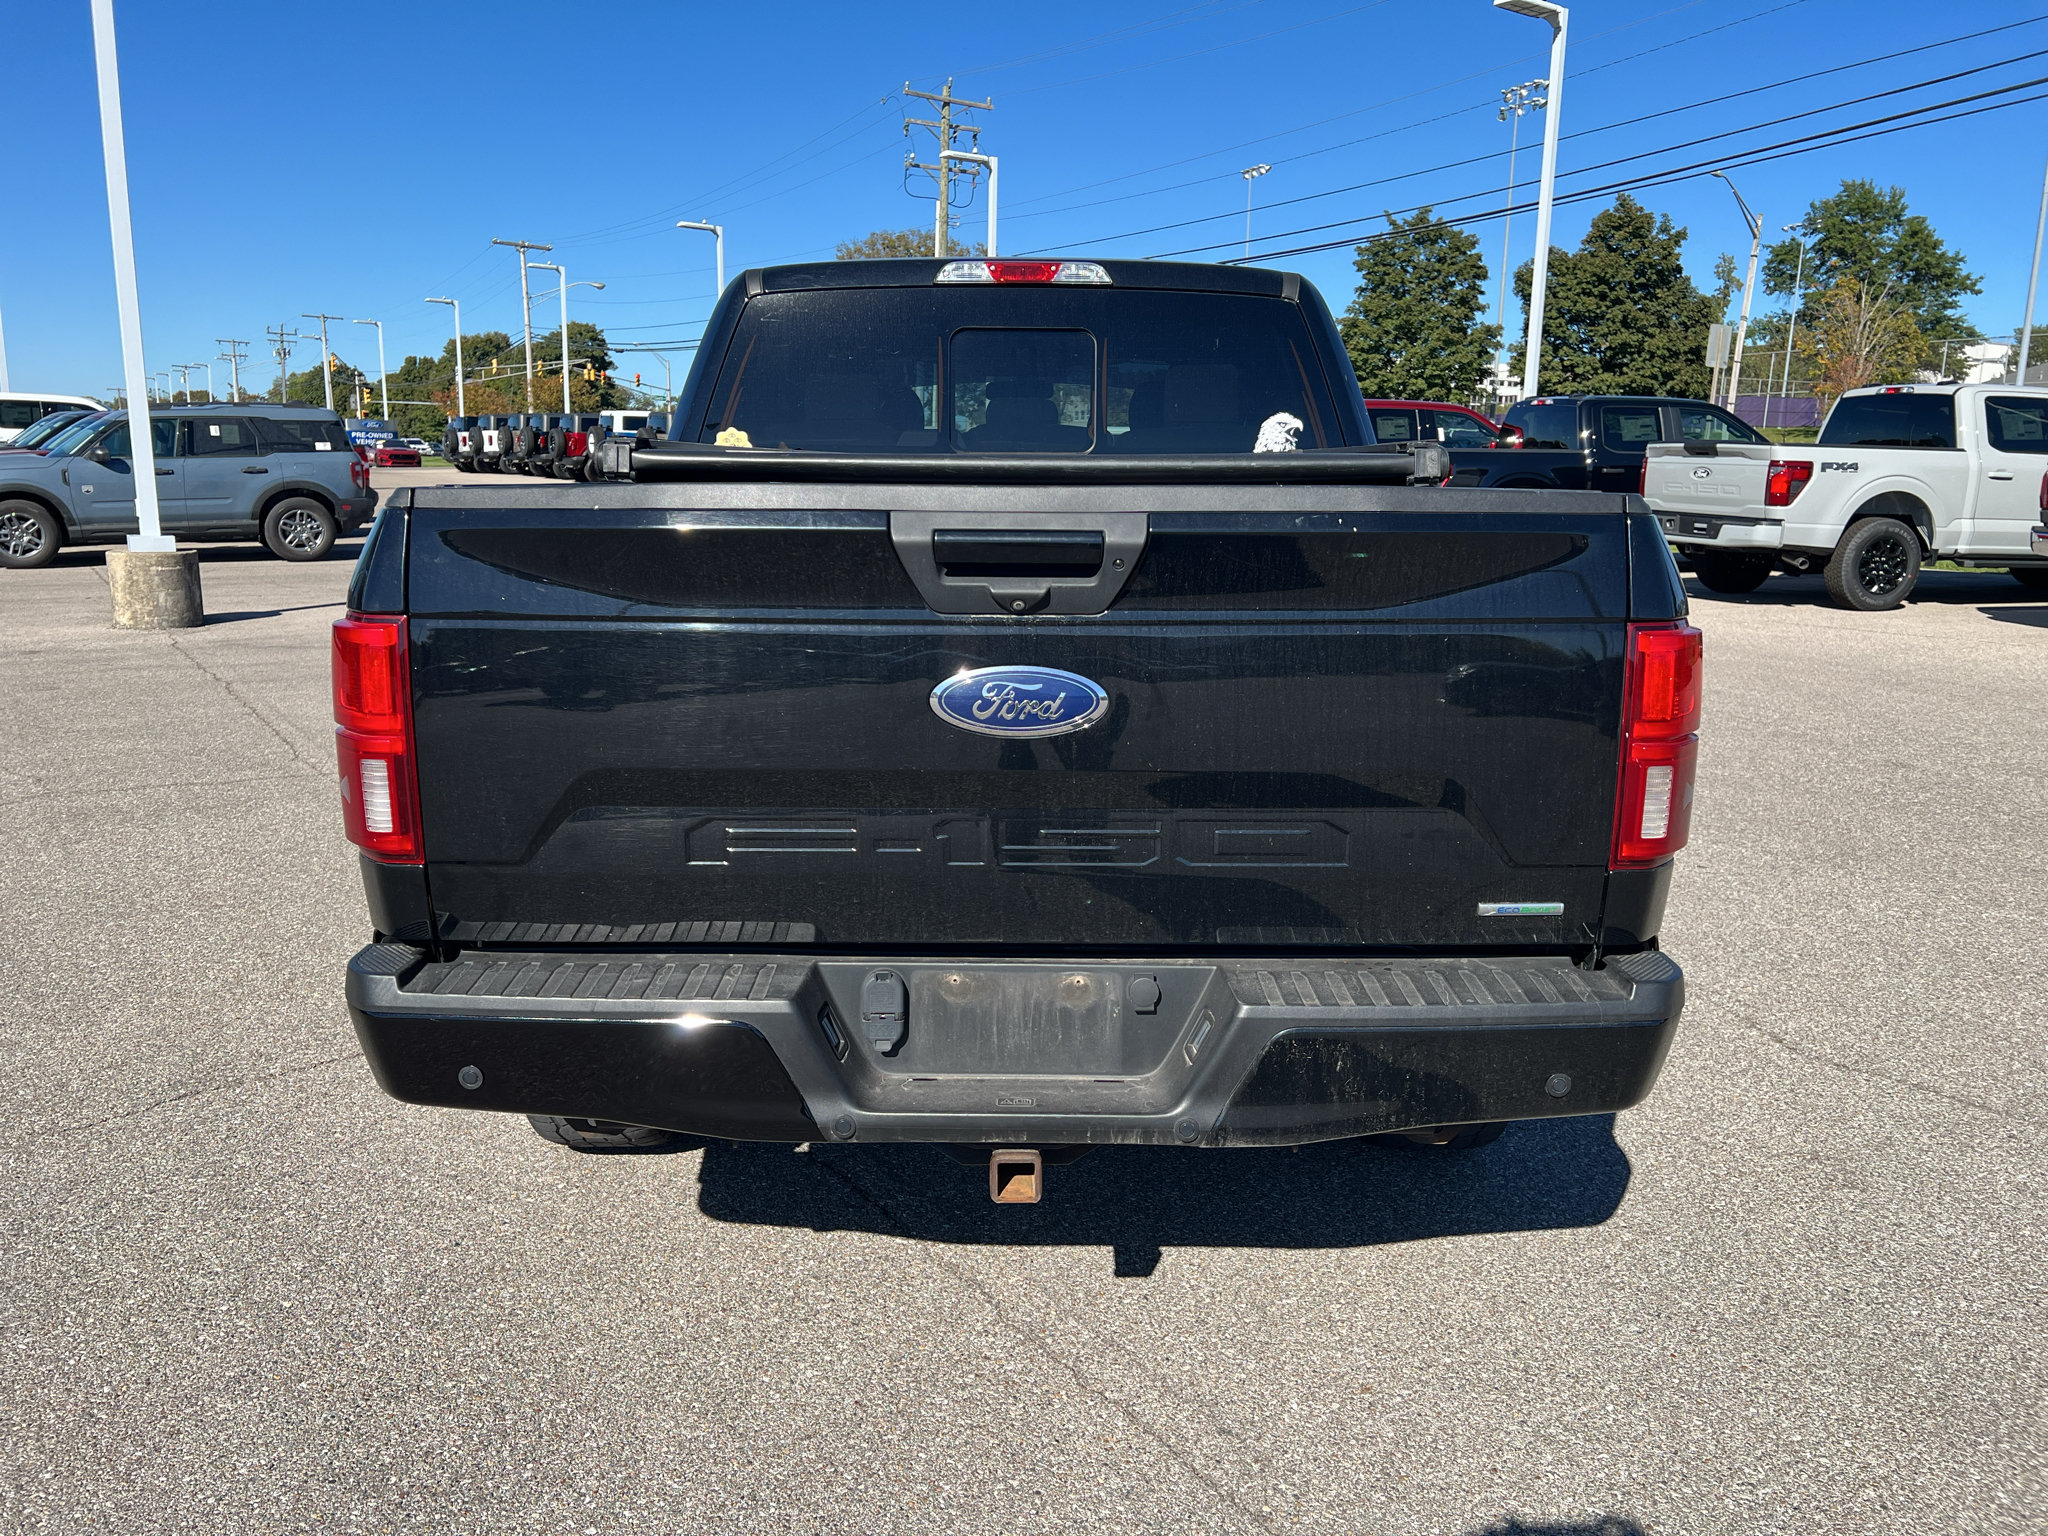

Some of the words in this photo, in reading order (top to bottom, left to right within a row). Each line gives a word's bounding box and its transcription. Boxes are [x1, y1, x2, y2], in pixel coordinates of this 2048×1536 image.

[351, 431, 394, 439] PRE-OWNED
[1820, 461, 1859, 473] FX4
[1662, 481, 1741, 496] F-150
[972, 681, 1067, 720] Ford
[684, 815, 1350, 866] F-150
